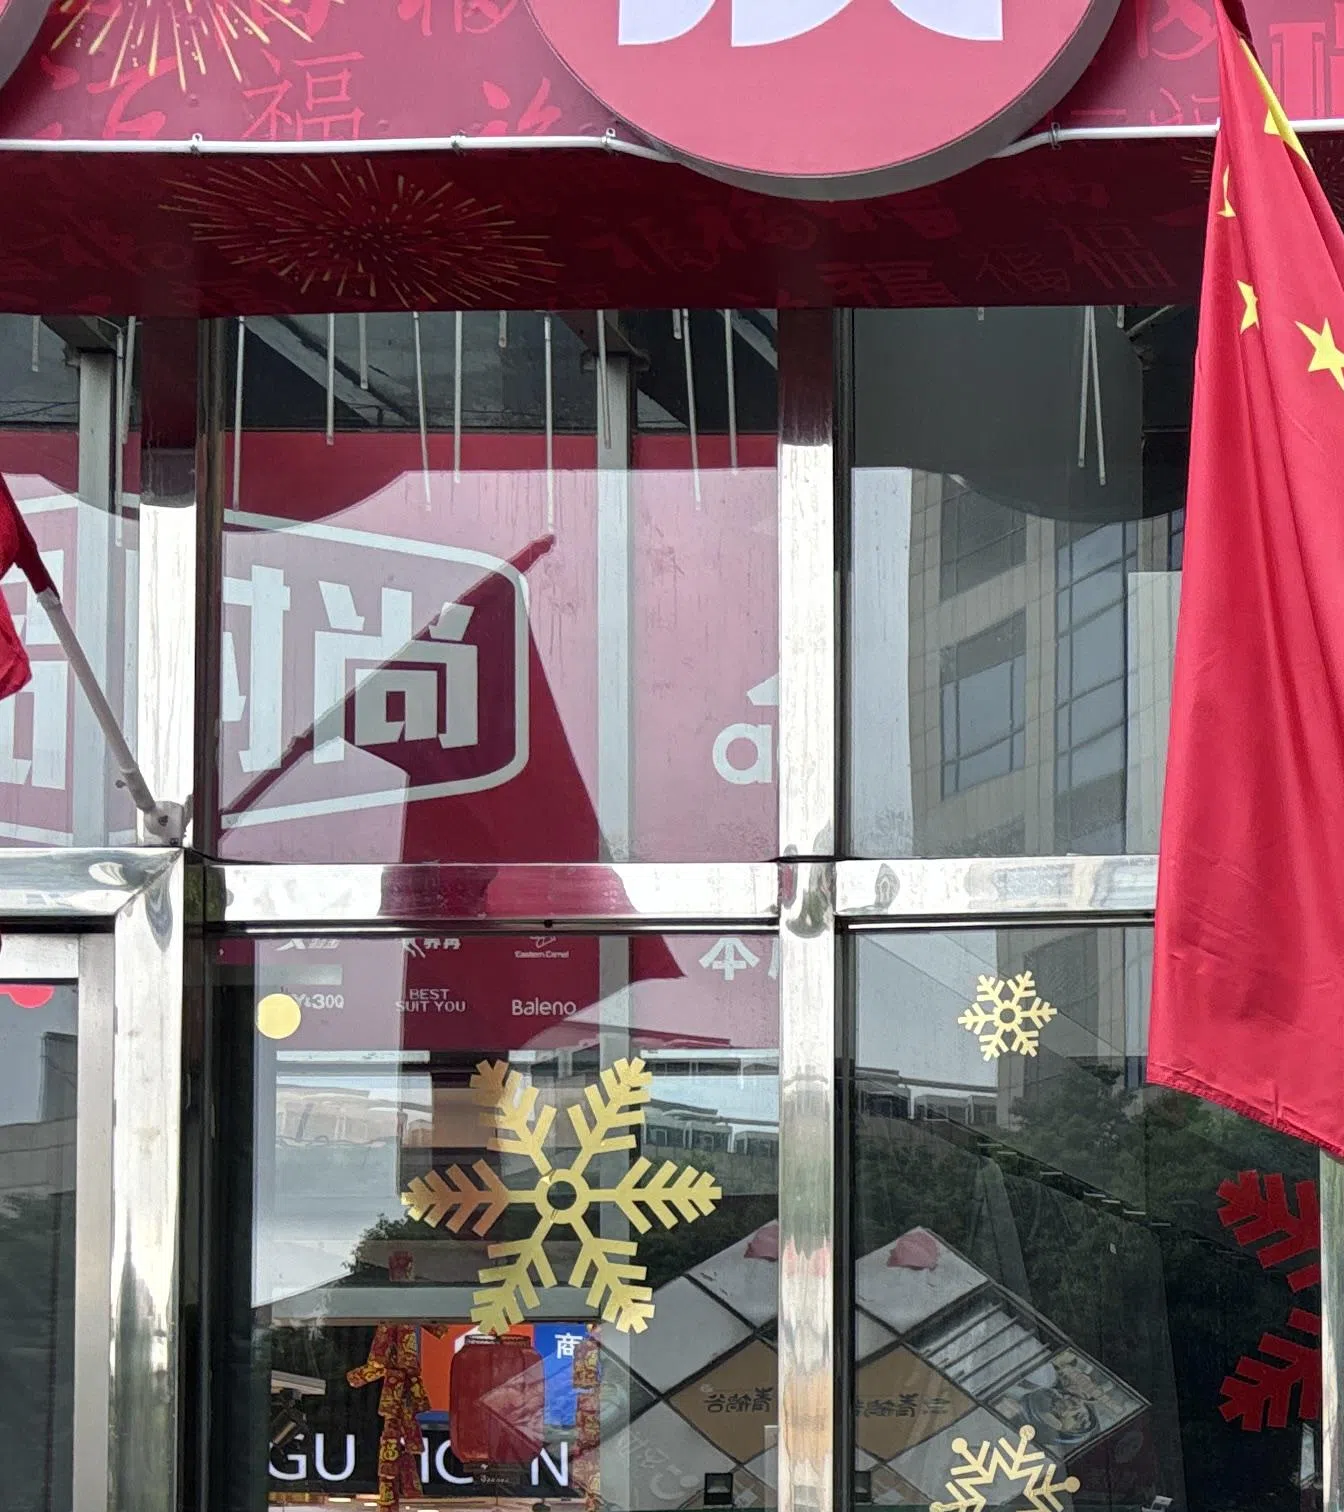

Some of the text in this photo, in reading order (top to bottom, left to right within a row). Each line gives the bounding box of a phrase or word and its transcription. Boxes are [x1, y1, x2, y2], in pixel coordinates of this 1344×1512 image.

[242, 50, 365, 140] 福
[409, 988, 450, 1001] BEST
[395, 1000, 467, 1013] SUIT YOU
[511, 996, 577, 1017] Baleno
